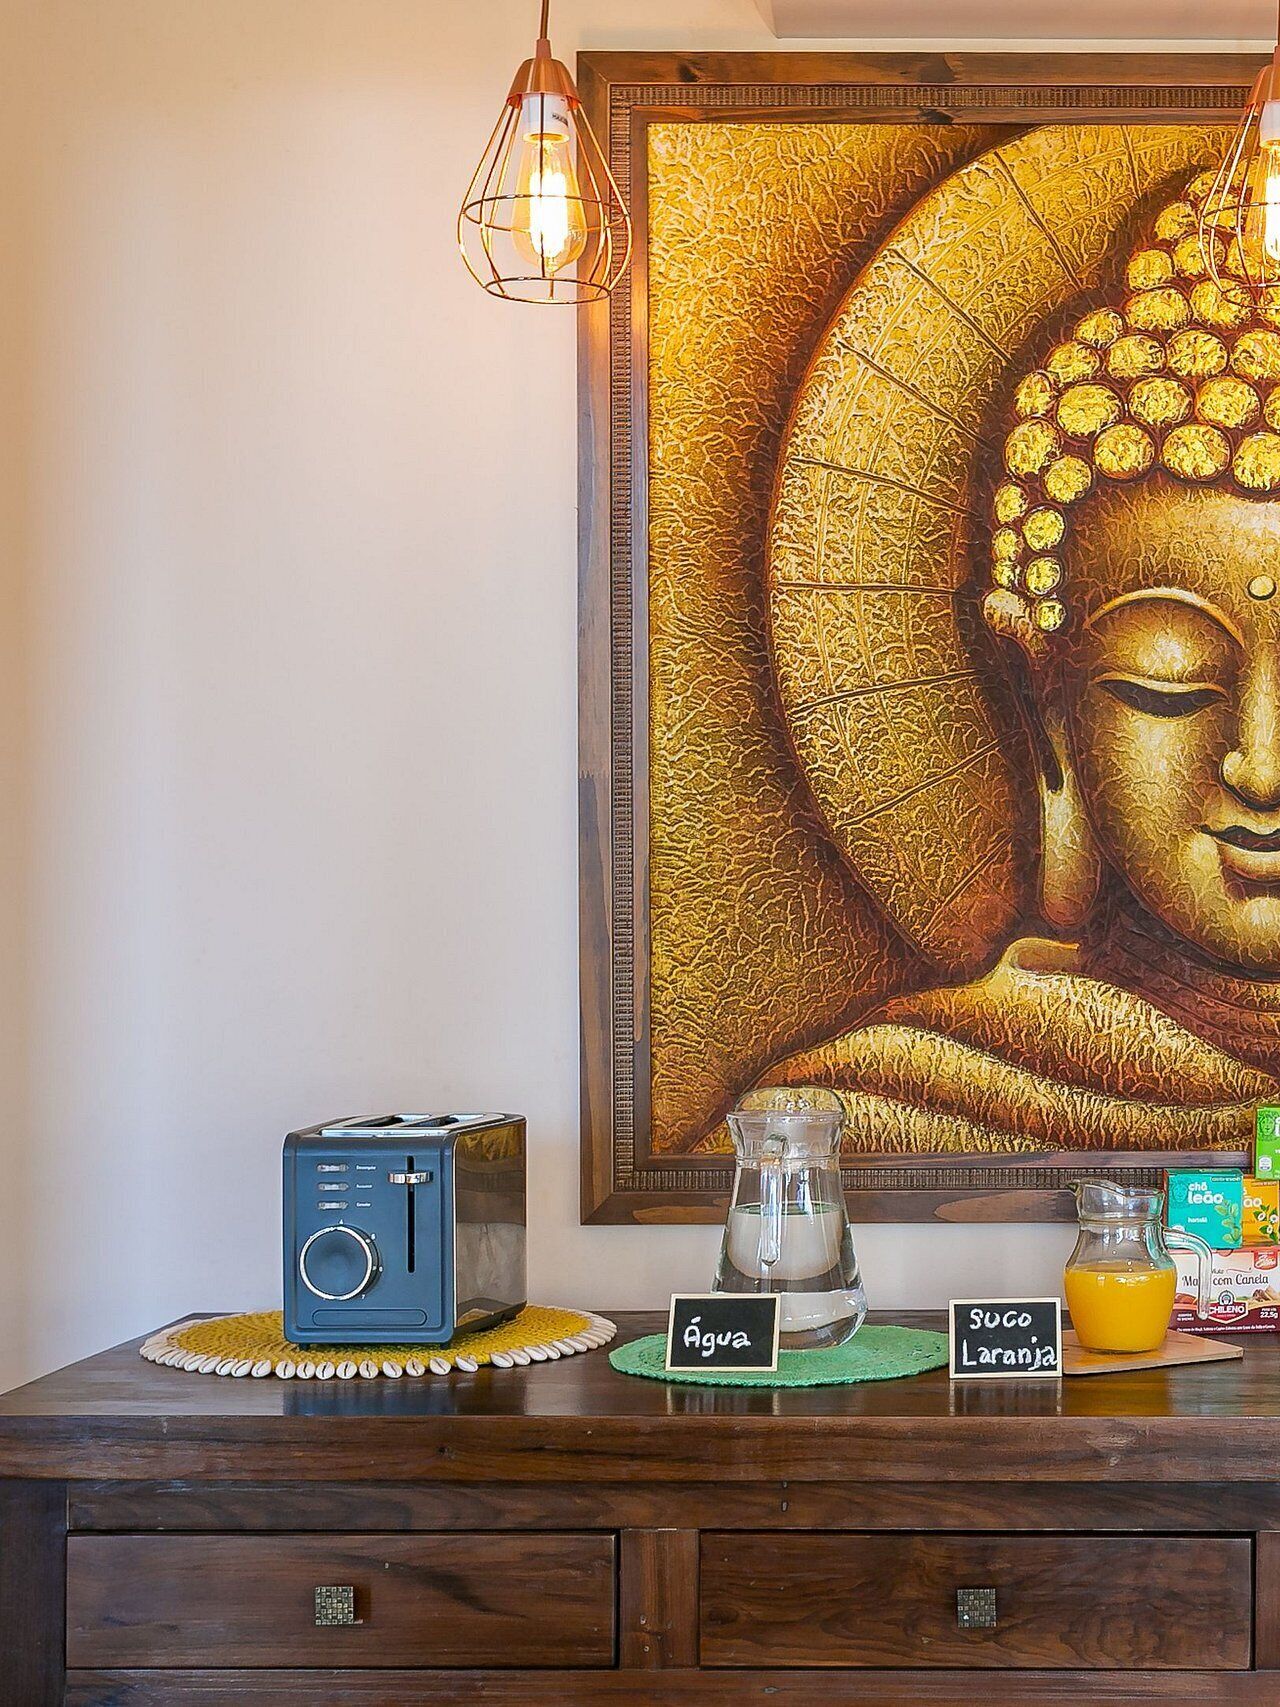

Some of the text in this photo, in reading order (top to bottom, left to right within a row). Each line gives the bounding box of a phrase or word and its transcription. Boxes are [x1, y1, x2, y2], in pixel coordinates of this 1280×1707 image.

[1188, 1191, 1223, 1204] leão
[1243, 1196, 1262, 1207] ão
[1213, 1277, 1232, 1286] com
[1236, 1274, 1269, 1285] Canela
[683, 1316, 752, 1358] Água
[962, 1335, 1058, 1371] Laranja
